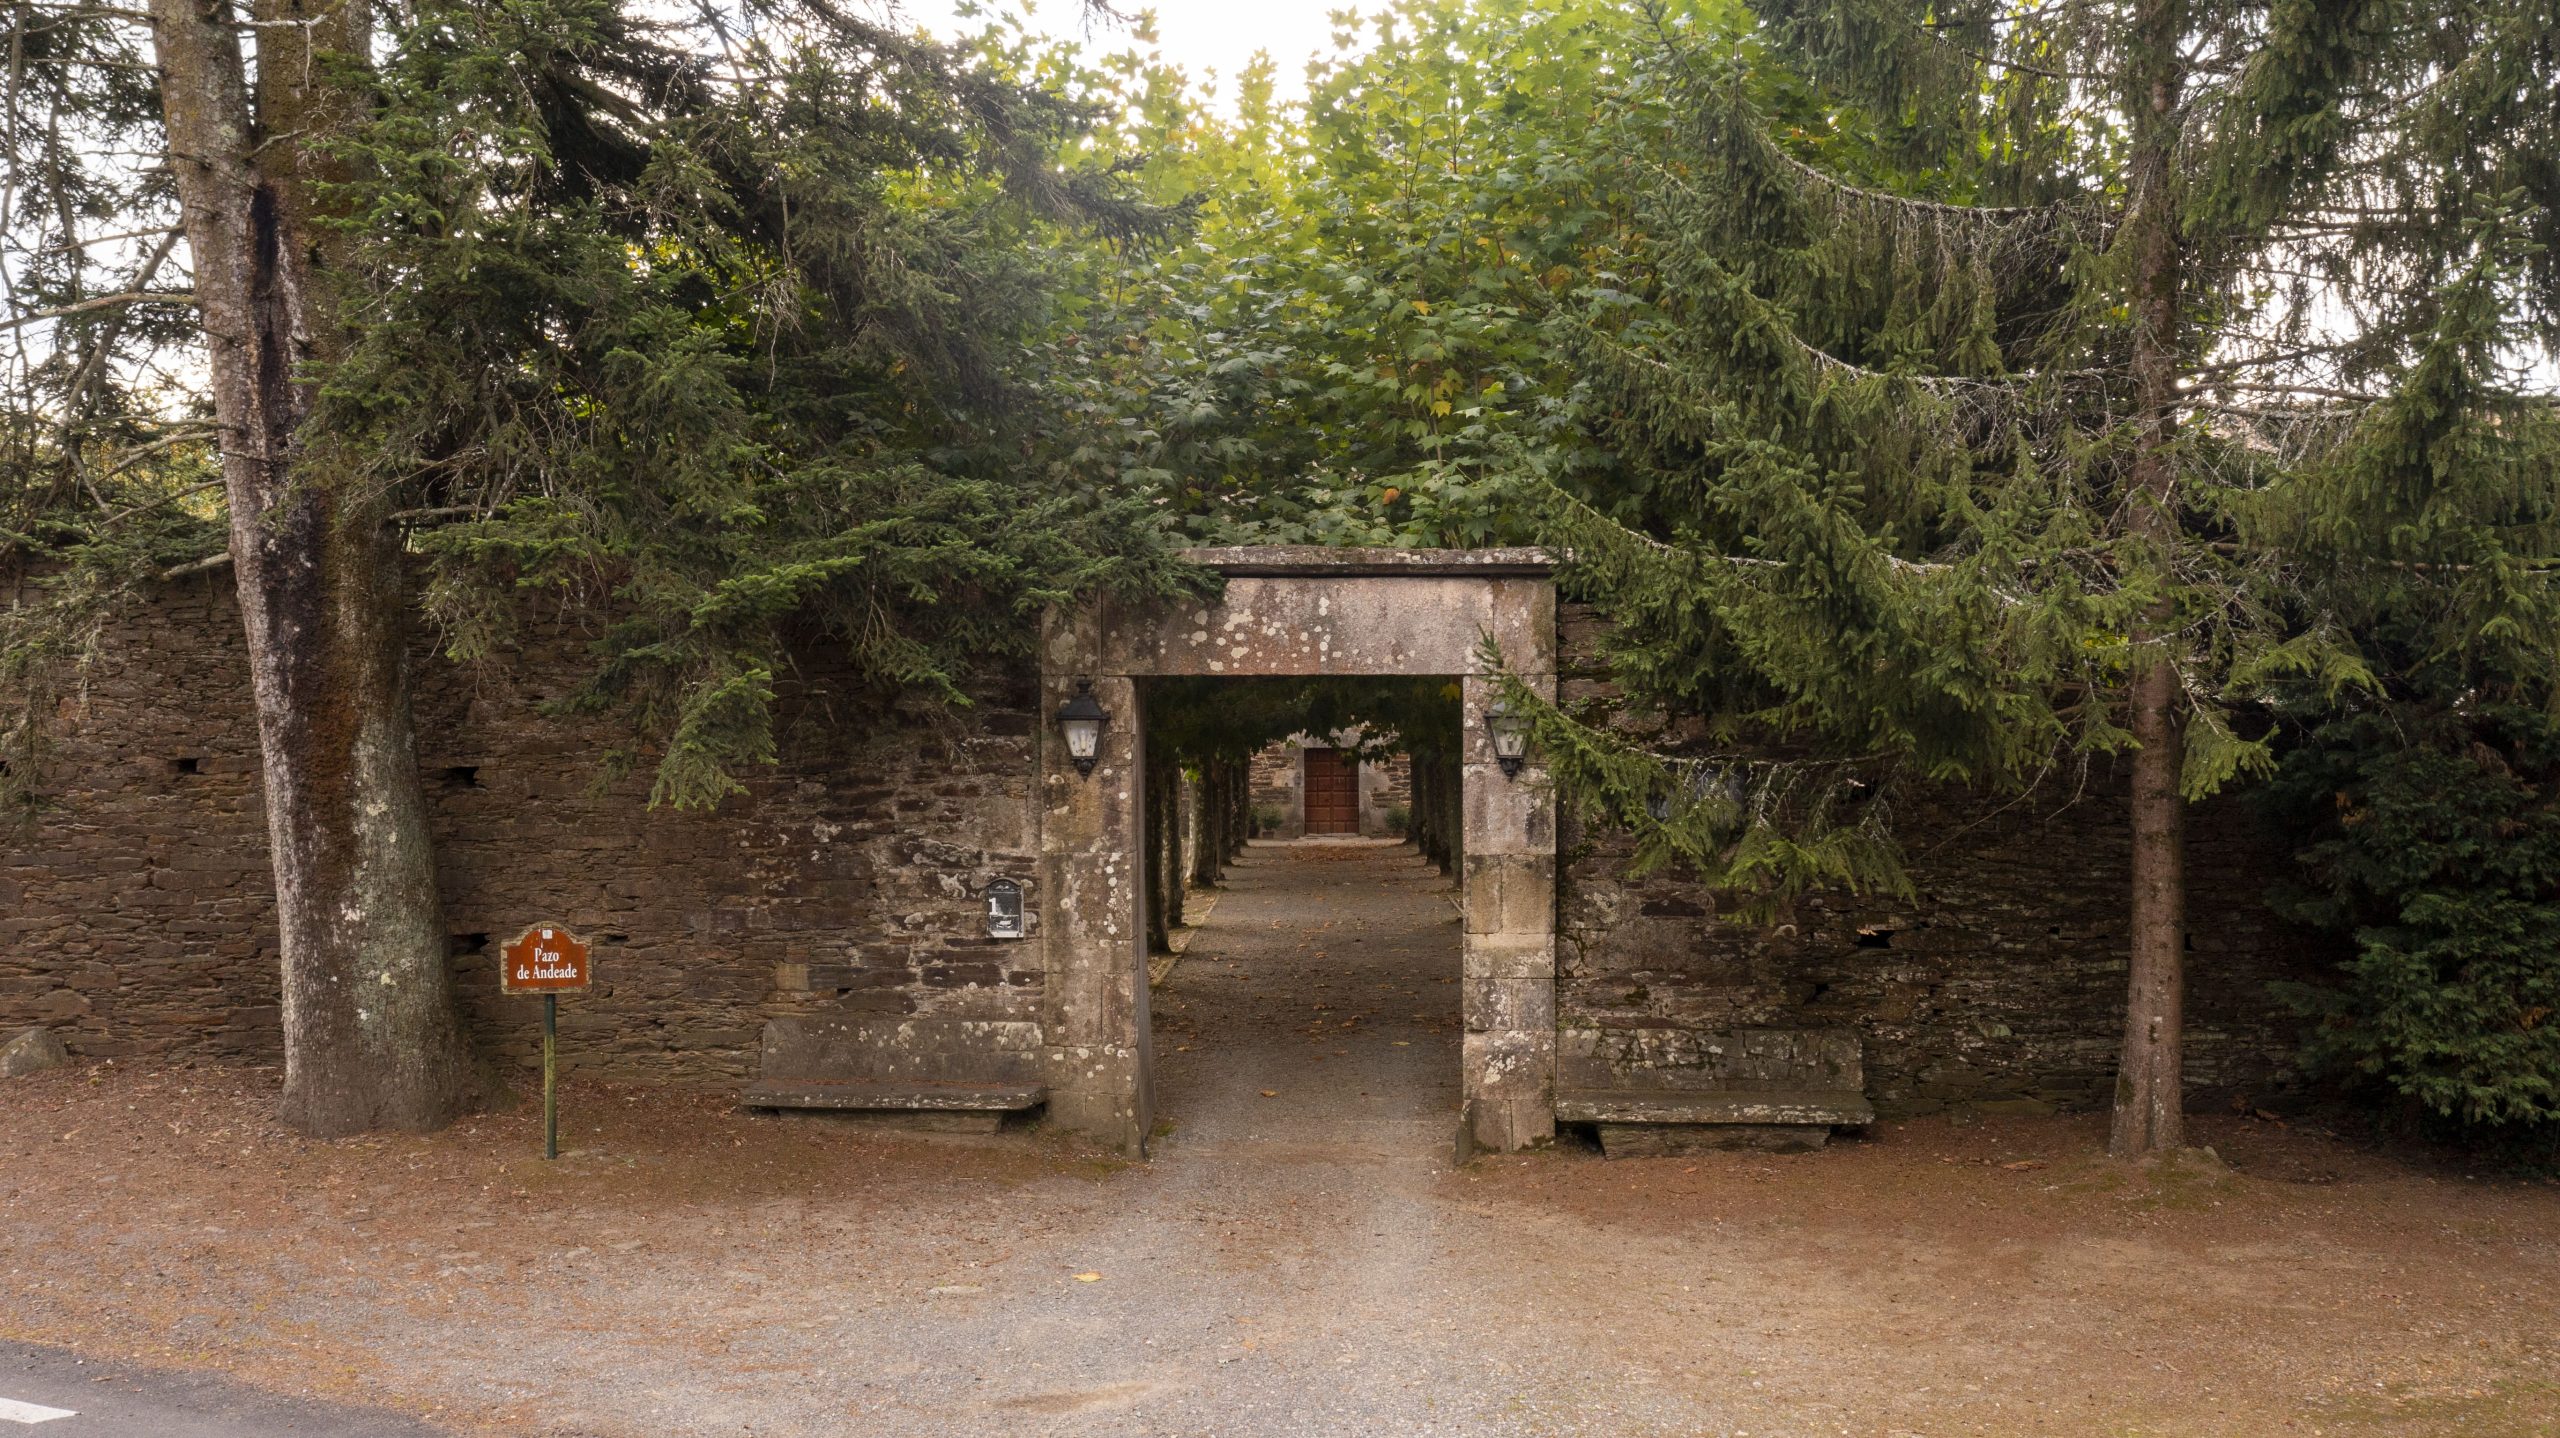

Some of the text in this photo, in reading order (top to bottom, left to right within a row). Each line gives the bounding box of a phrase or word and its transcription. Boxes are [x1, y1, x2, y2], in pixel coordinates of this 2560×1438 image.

[988, 897, 998, 915] 1
[534, 947, 560, 962] Pazo
[517, 963, 577, 980] de Andeade
